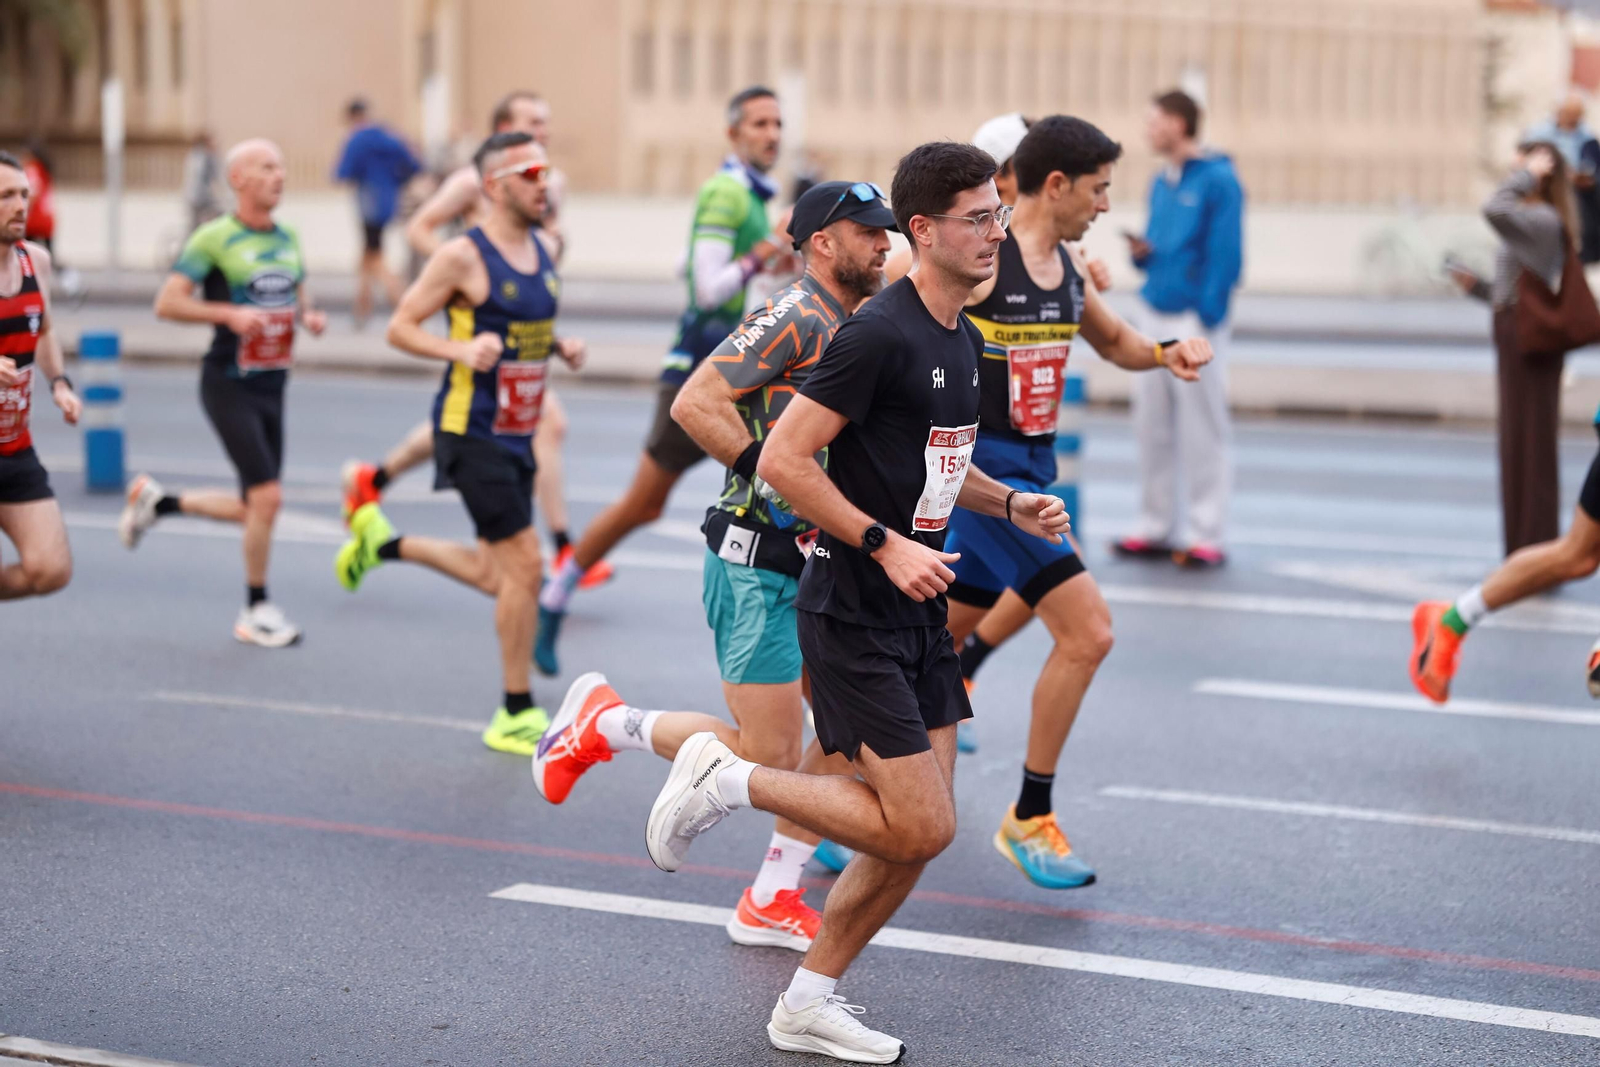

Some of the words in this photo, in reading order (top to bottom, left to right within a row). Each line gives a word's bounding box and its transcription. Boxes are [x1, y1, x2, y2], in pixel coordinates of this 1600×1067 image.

[995, 330, 1020, 343] CLUB
[1032, 366, 1056, 385] 802
[693, 757, 722, 790] SALOMON
